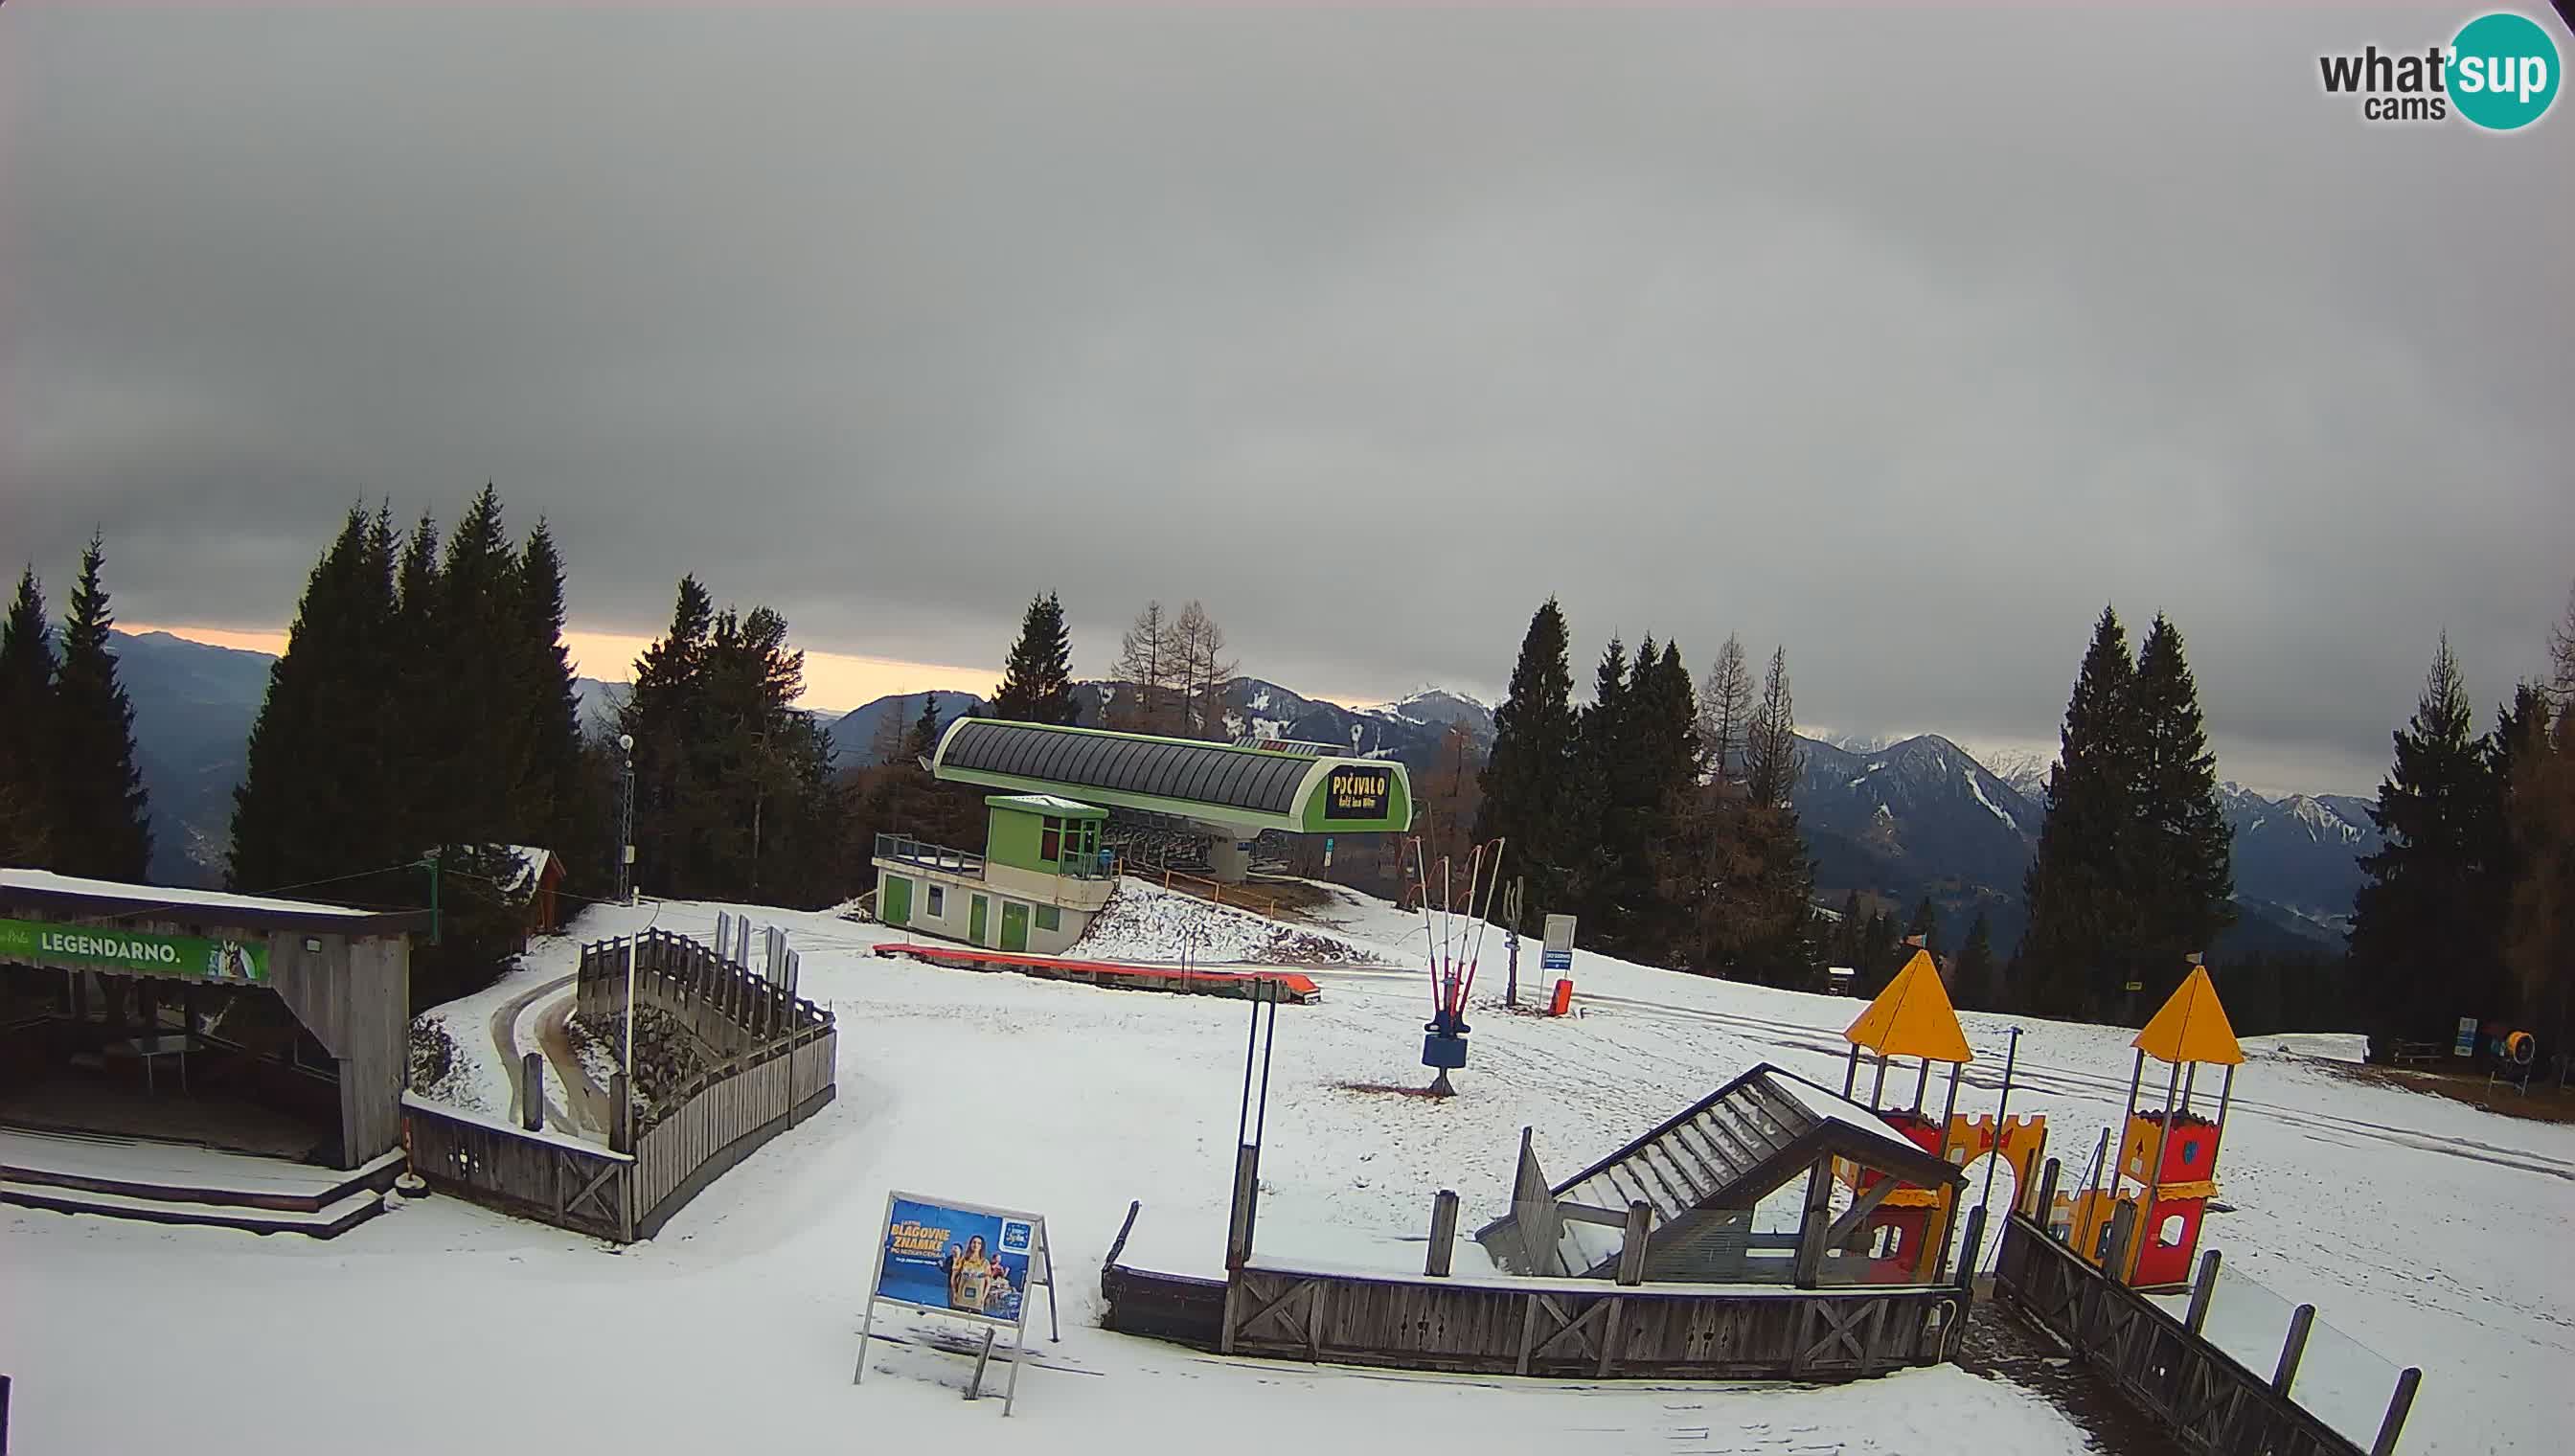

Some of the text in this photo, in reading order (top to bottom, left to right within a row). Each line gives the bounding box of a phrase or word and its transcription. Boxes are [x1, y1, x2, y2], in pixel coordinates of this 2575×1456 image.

[41, 932, 181, 964] LEGENDARNO.
[891, 1224, 950, 1240] BLAGOVNE
[893, 1237, 944, 1251] ZNAMKE
